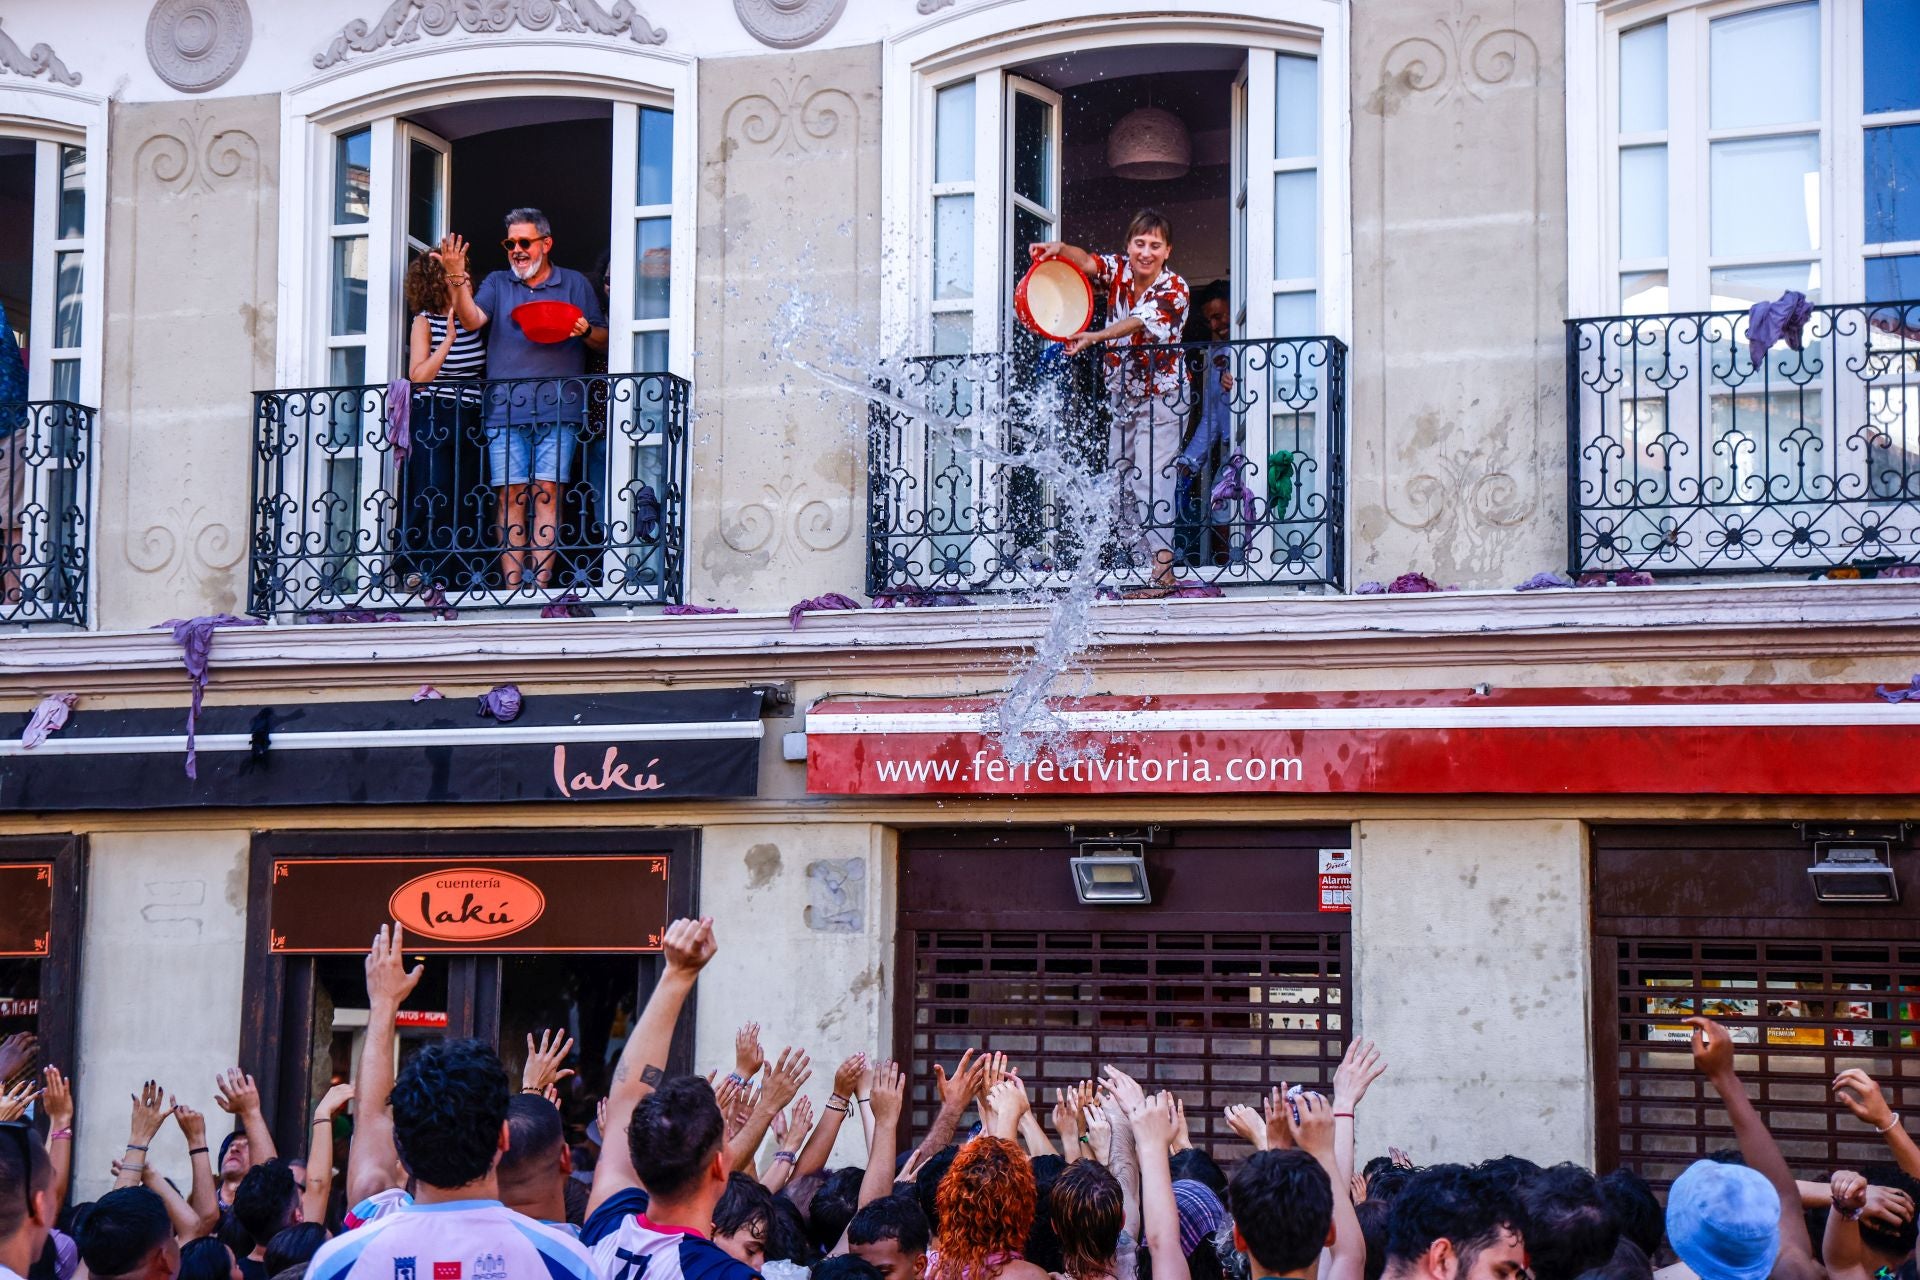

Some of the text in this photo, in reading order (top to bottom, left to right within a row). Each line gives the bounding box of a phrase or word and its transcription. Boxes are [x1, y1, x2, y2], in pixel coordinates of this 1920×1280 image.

[554, 745, 665, 797] lakú
[876, 750, 1302, 782] www.ferrettivitoria.com
[436, 878, 500, 889] cuentería
[421, 892, 514, 928] lakú
[425, 1012, 446, 1022] ROPA
[1767, 1030, 1796, 1038] PREMIUM
